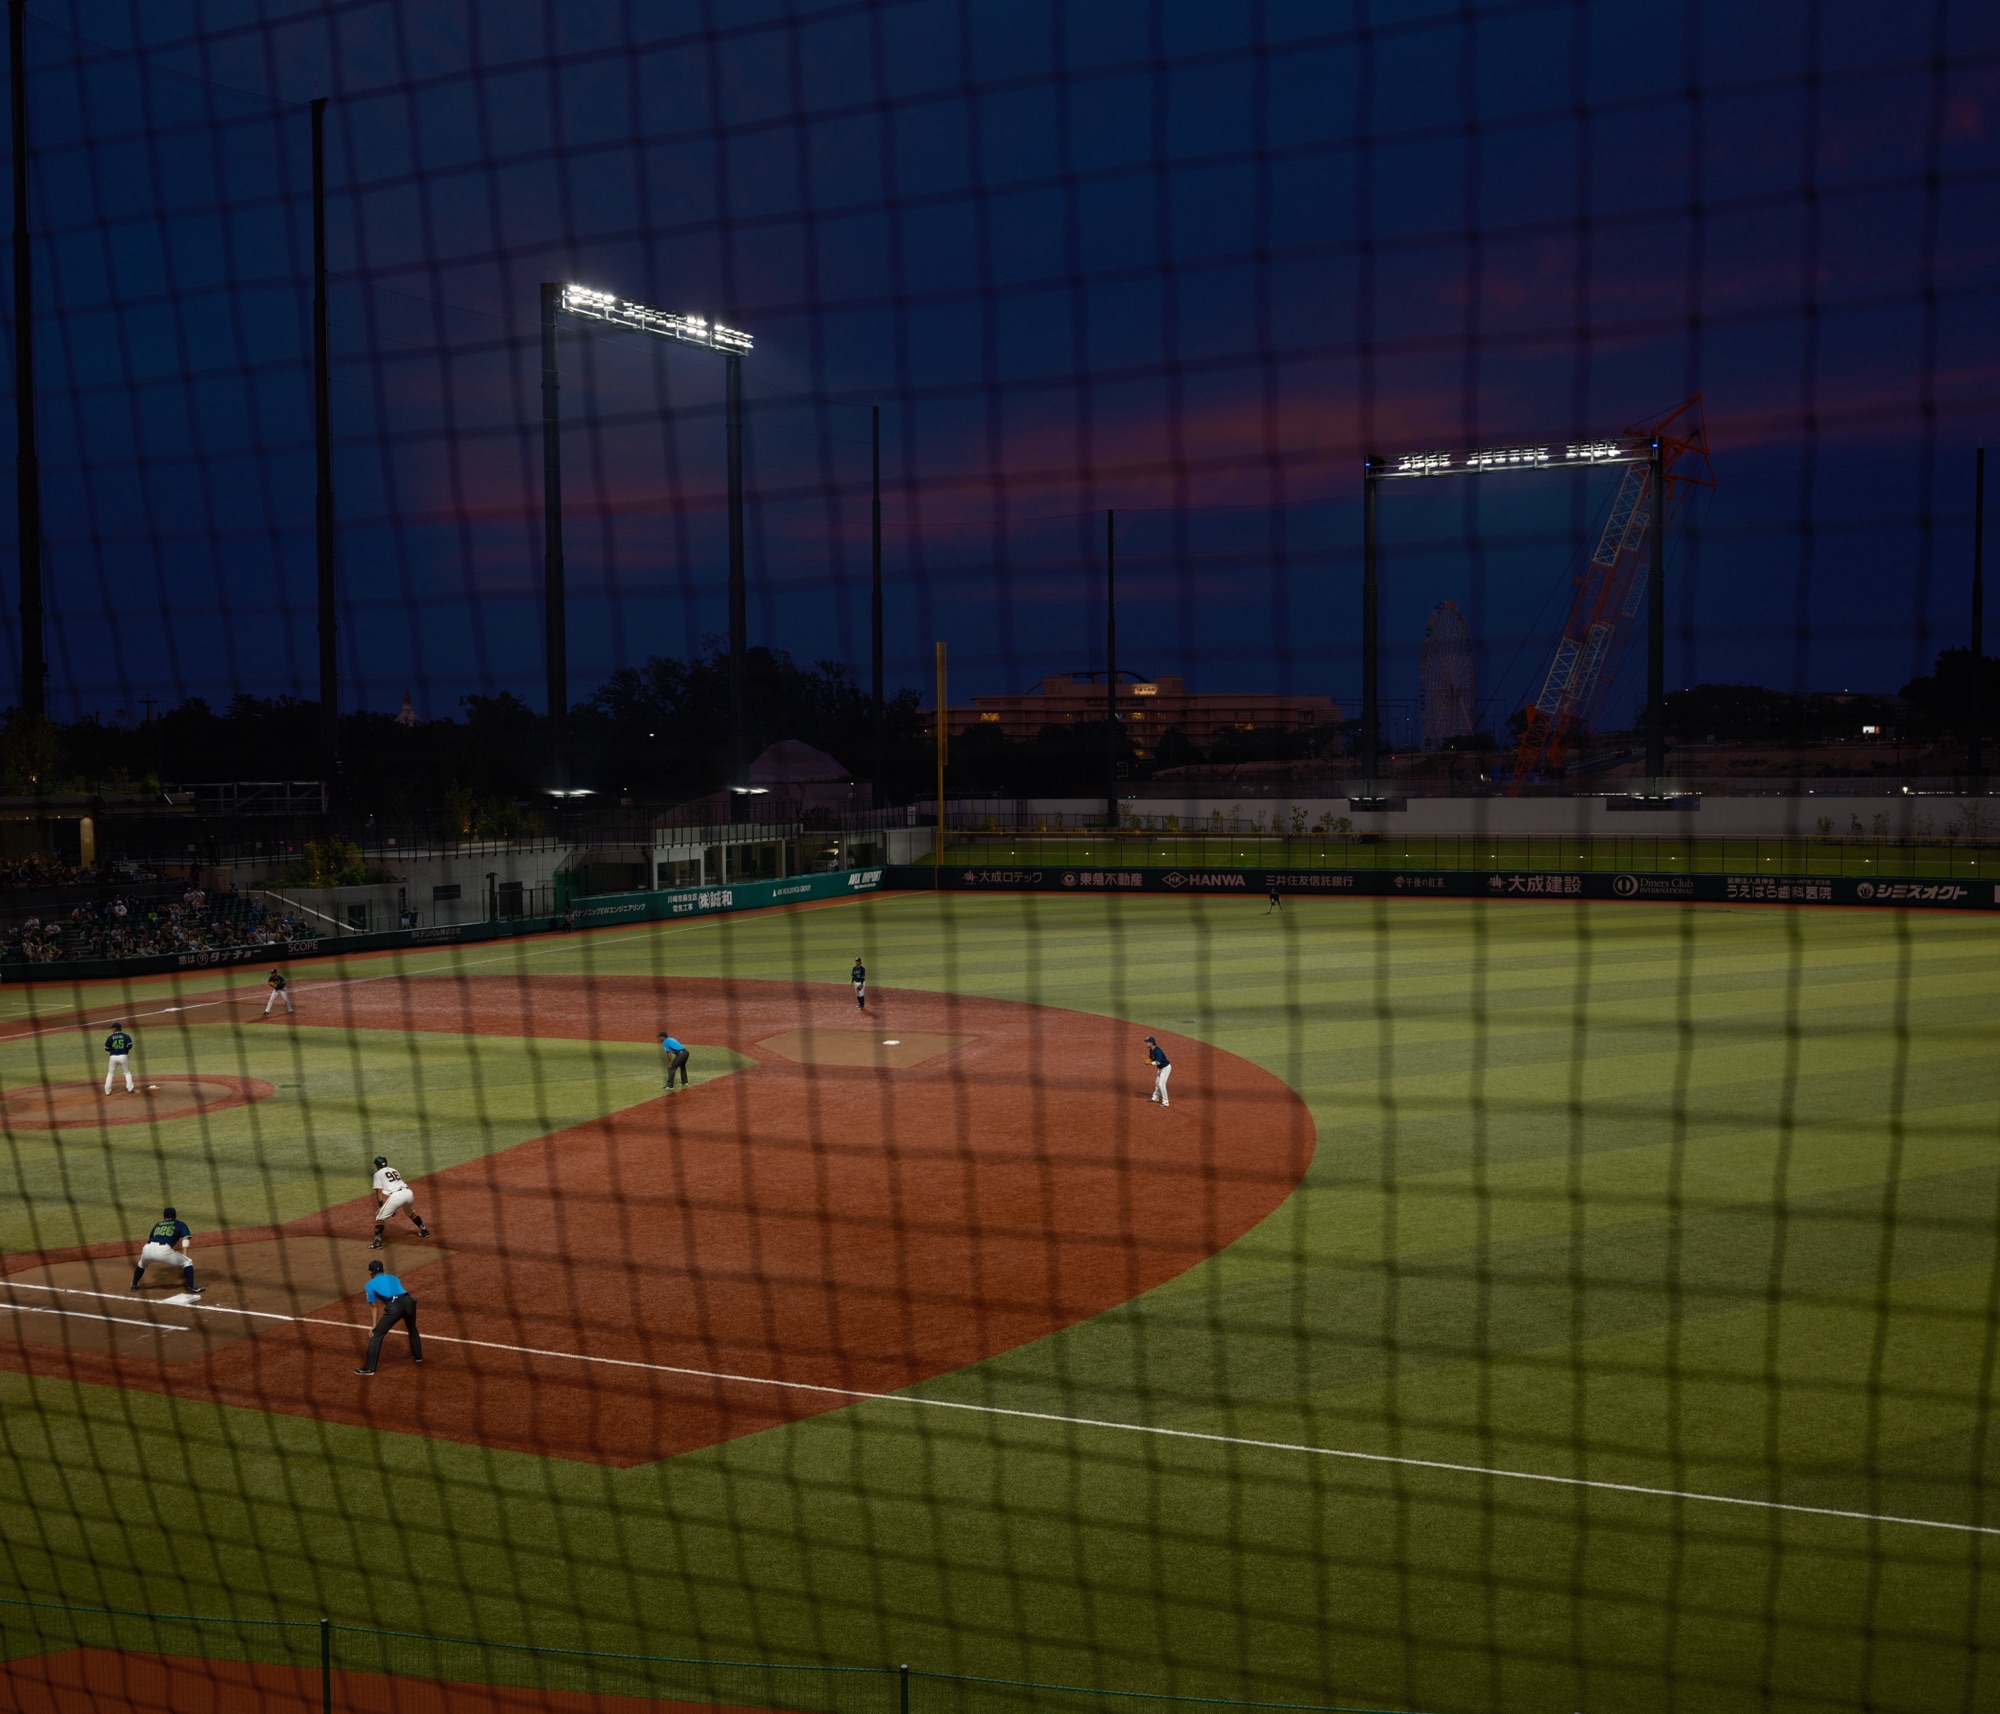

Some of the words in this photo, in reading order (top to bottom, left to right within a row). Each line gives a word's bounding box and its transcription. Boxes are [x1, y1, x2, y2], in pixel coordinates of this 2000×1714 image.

[979, 870, 1043, 883] 大成ロテック
[1080, 872, 1143, 887] 東急不動産
[1168, 875, 1182, 884] HK
[1189, 874, 1246, 887] HANWA
[1265, 875, 1354, 887] 三井住友信託銀行
[1405, 877, 1446, 888] 午後の紅茶
[1508, 875, 1582, 894] 大成建設
[1640, 878, 1670, 888] Diners
[1671, 878, 1694, 888] Club
[1726, 884, 1832, 900] うえはら歯科医院
[1876, 884, 1968, 900] シミズオクト
[288, 941, 318, 953] SCOPE
[210, 949, 262, 963] タナチョー
[112, 1039, 125, 1050] 45
[385, 1171, 400, 1183] 96
